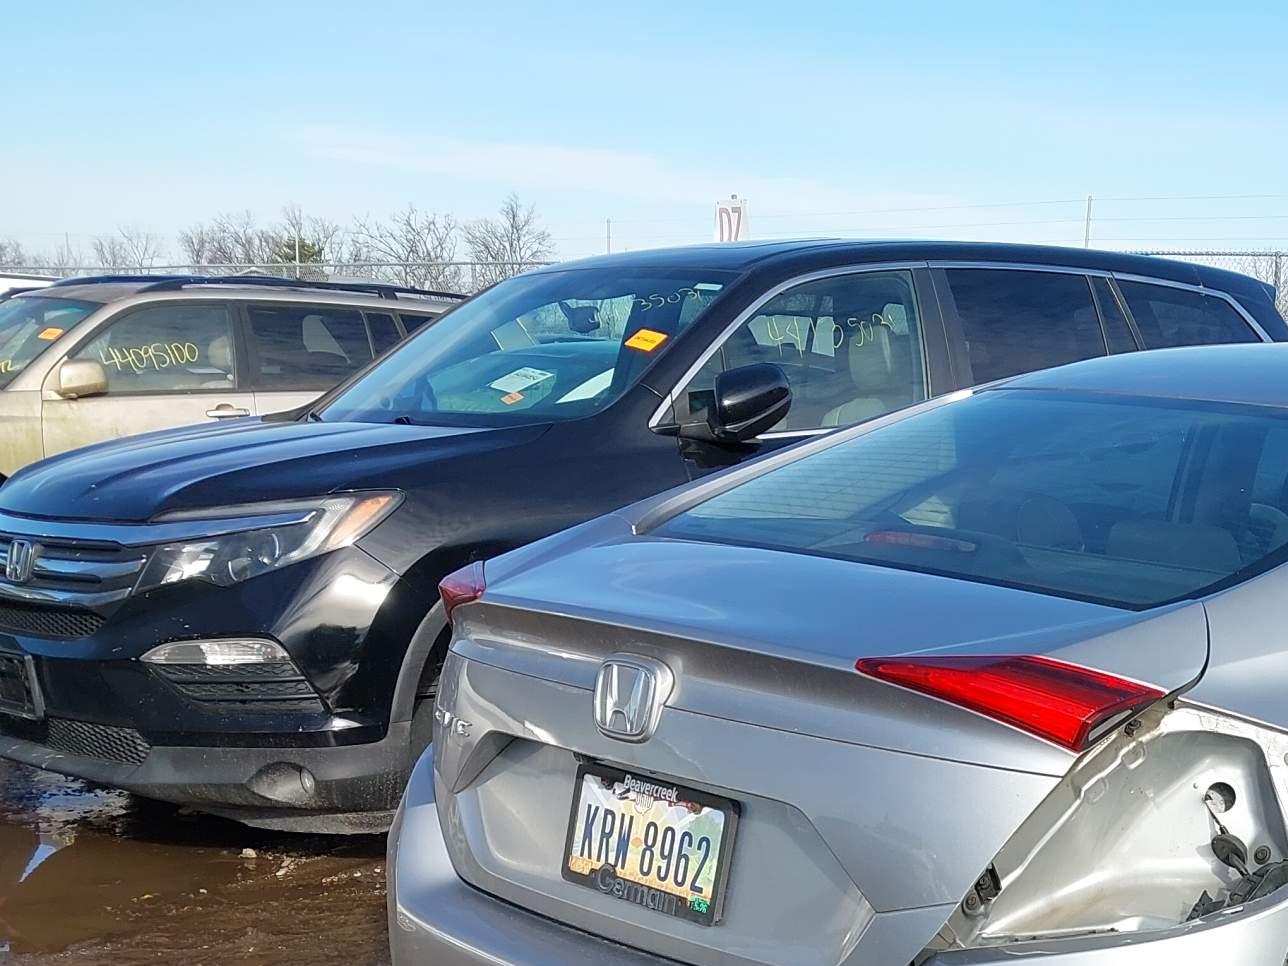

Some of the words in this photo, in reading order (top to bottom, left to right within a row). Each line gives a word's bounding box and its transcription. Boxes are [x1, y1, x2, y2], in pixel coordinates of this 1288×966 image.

[100, 342, 199, 371] 44095100
[623, 774, 678, 802] Beavercreek
[579, 803, 634, 870] KRW
[639, 821, 711, 894] 8962
